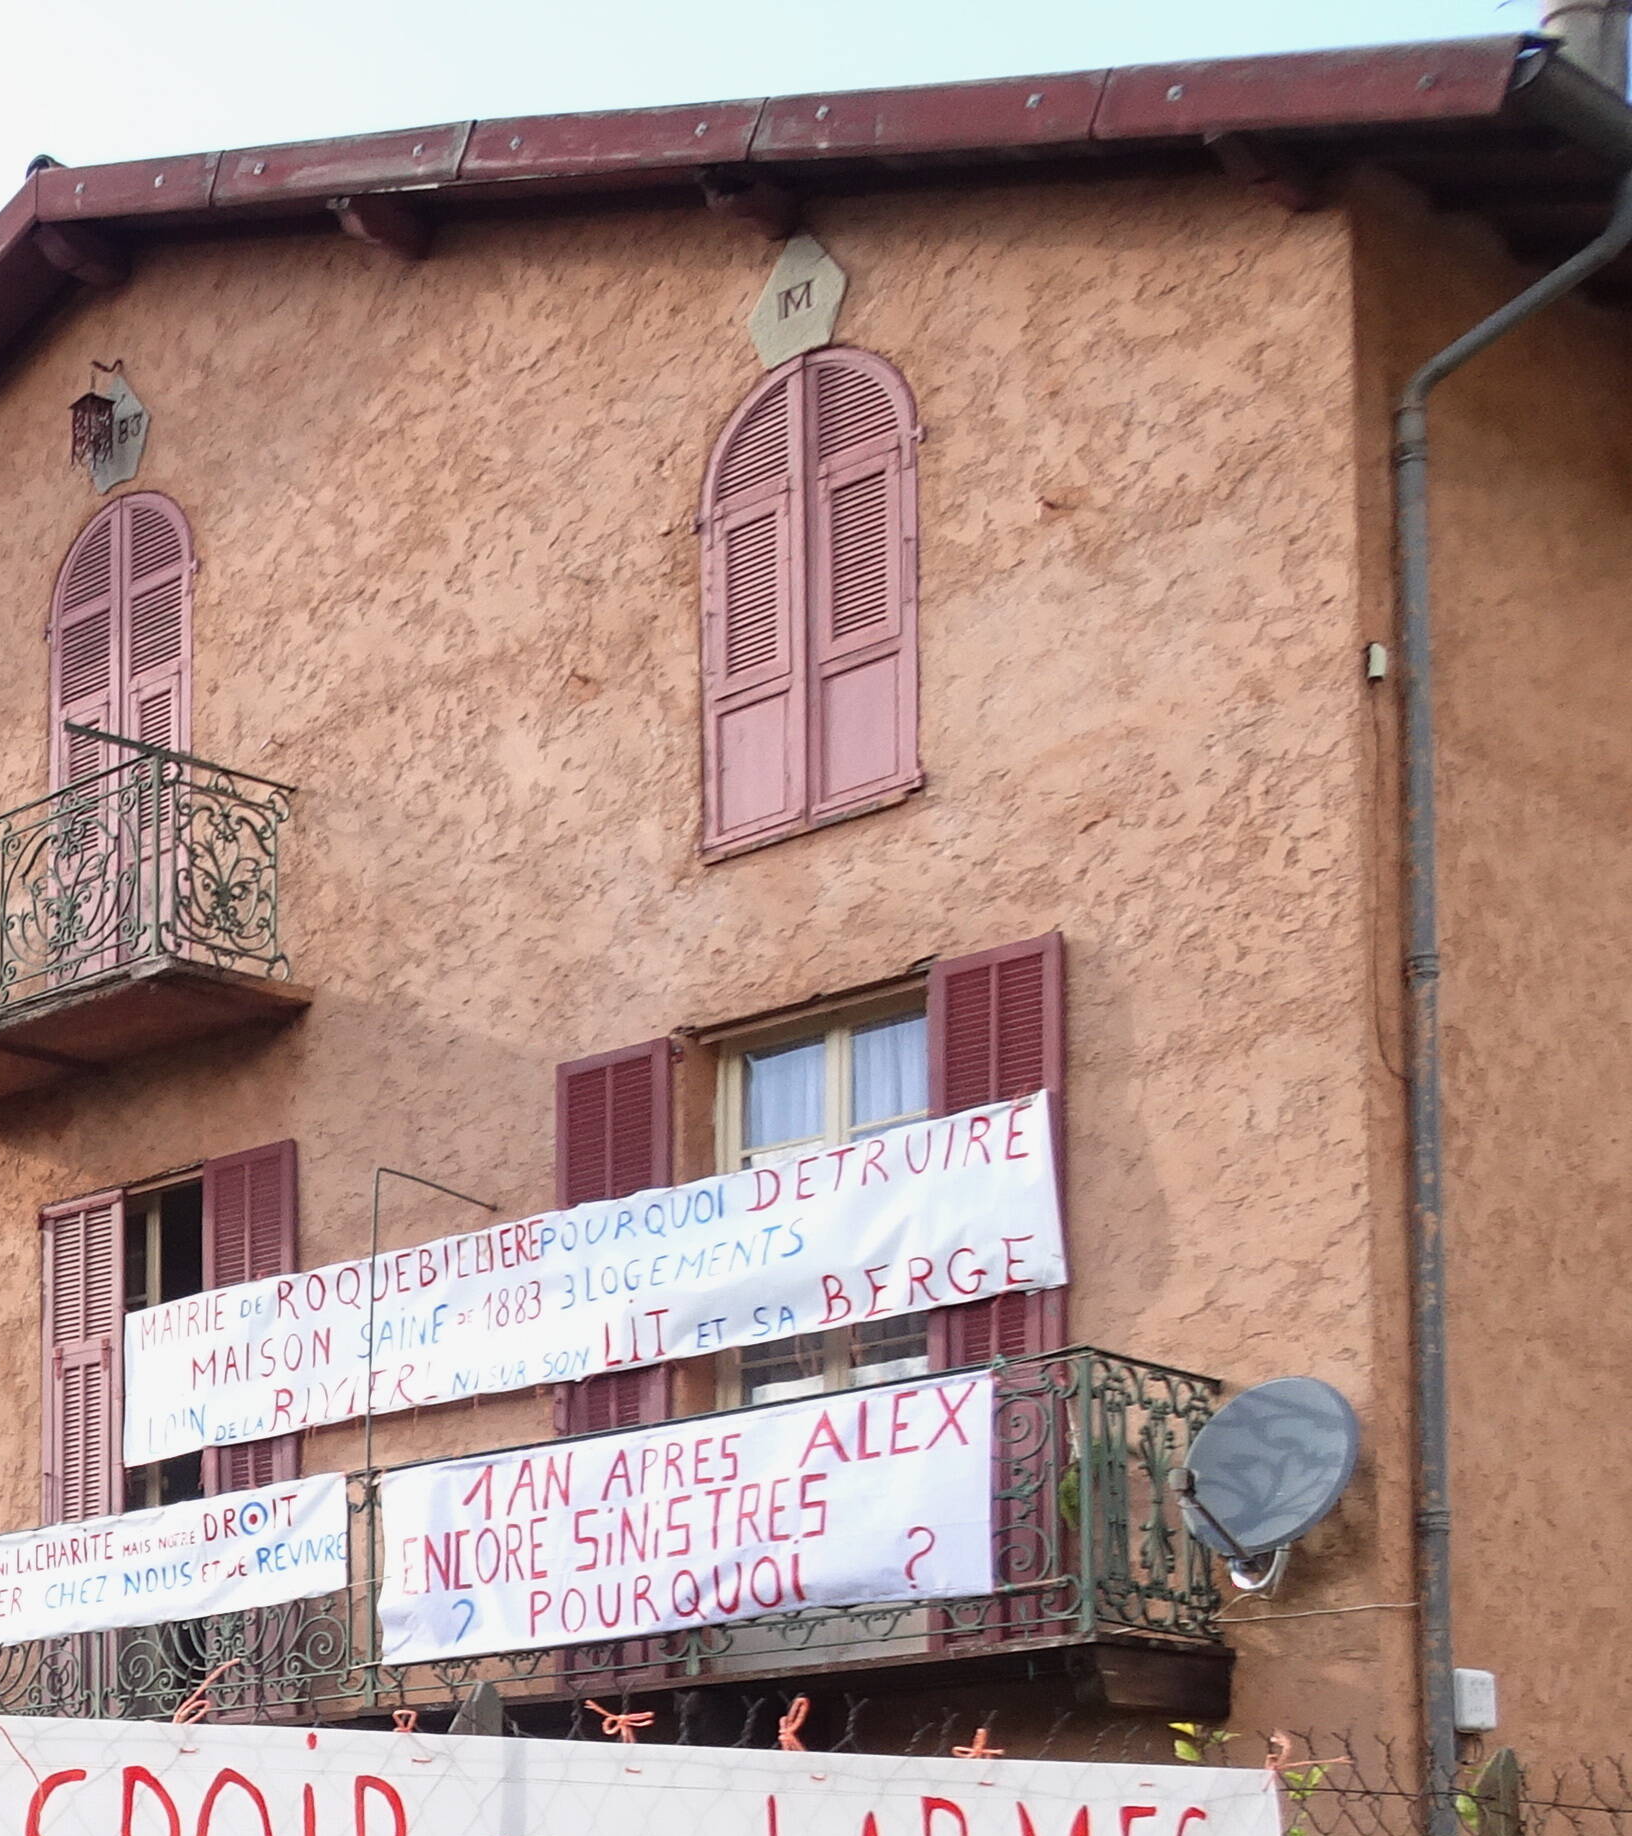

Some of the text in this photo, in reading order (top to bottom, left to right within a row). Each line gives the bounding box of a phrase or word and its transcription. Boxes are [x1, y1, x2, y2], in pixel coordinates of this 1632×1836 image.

[776, 277, 815, 322] M
[140, 1292, 228, 1351] MAIRIE
[239, 1298, 263, 1319] DE
[541, 1182, 724, 1256] POURQUOI
[746, 1104, 1034, 1212] DETRUIRE
[192, 1326, 332, 1391] MAISON
[481, 1280, 542, 1333] 1883
[585, 1217, 806, 1302] LOGEMENTS
[214, 1422, 237, 1442] DE
[243, 1415, 264, 1437] LA
[542, 1346, 590, 1378] SON
[603, 1298, 670, 1368] LIT
[697, 1316, 728, 1350] ET
[751, 1303, 796, 1338] SA
[818, 1234, 1035, 1325] BERGE
[462, 1382, 977, 1522] 1 AN APRES ALEX
[44, 1575, 108, 1610] CHEZ
[124, 1562, 193, 1596] NOUS
[123, 1538, 151, 1557] MAIS
[203, 1493, 298, 1542] DROIT
[401, 1472, 829, 1596] ENCORE SINISTRES
[529, 1540, 807, 1638] POURQUOI
